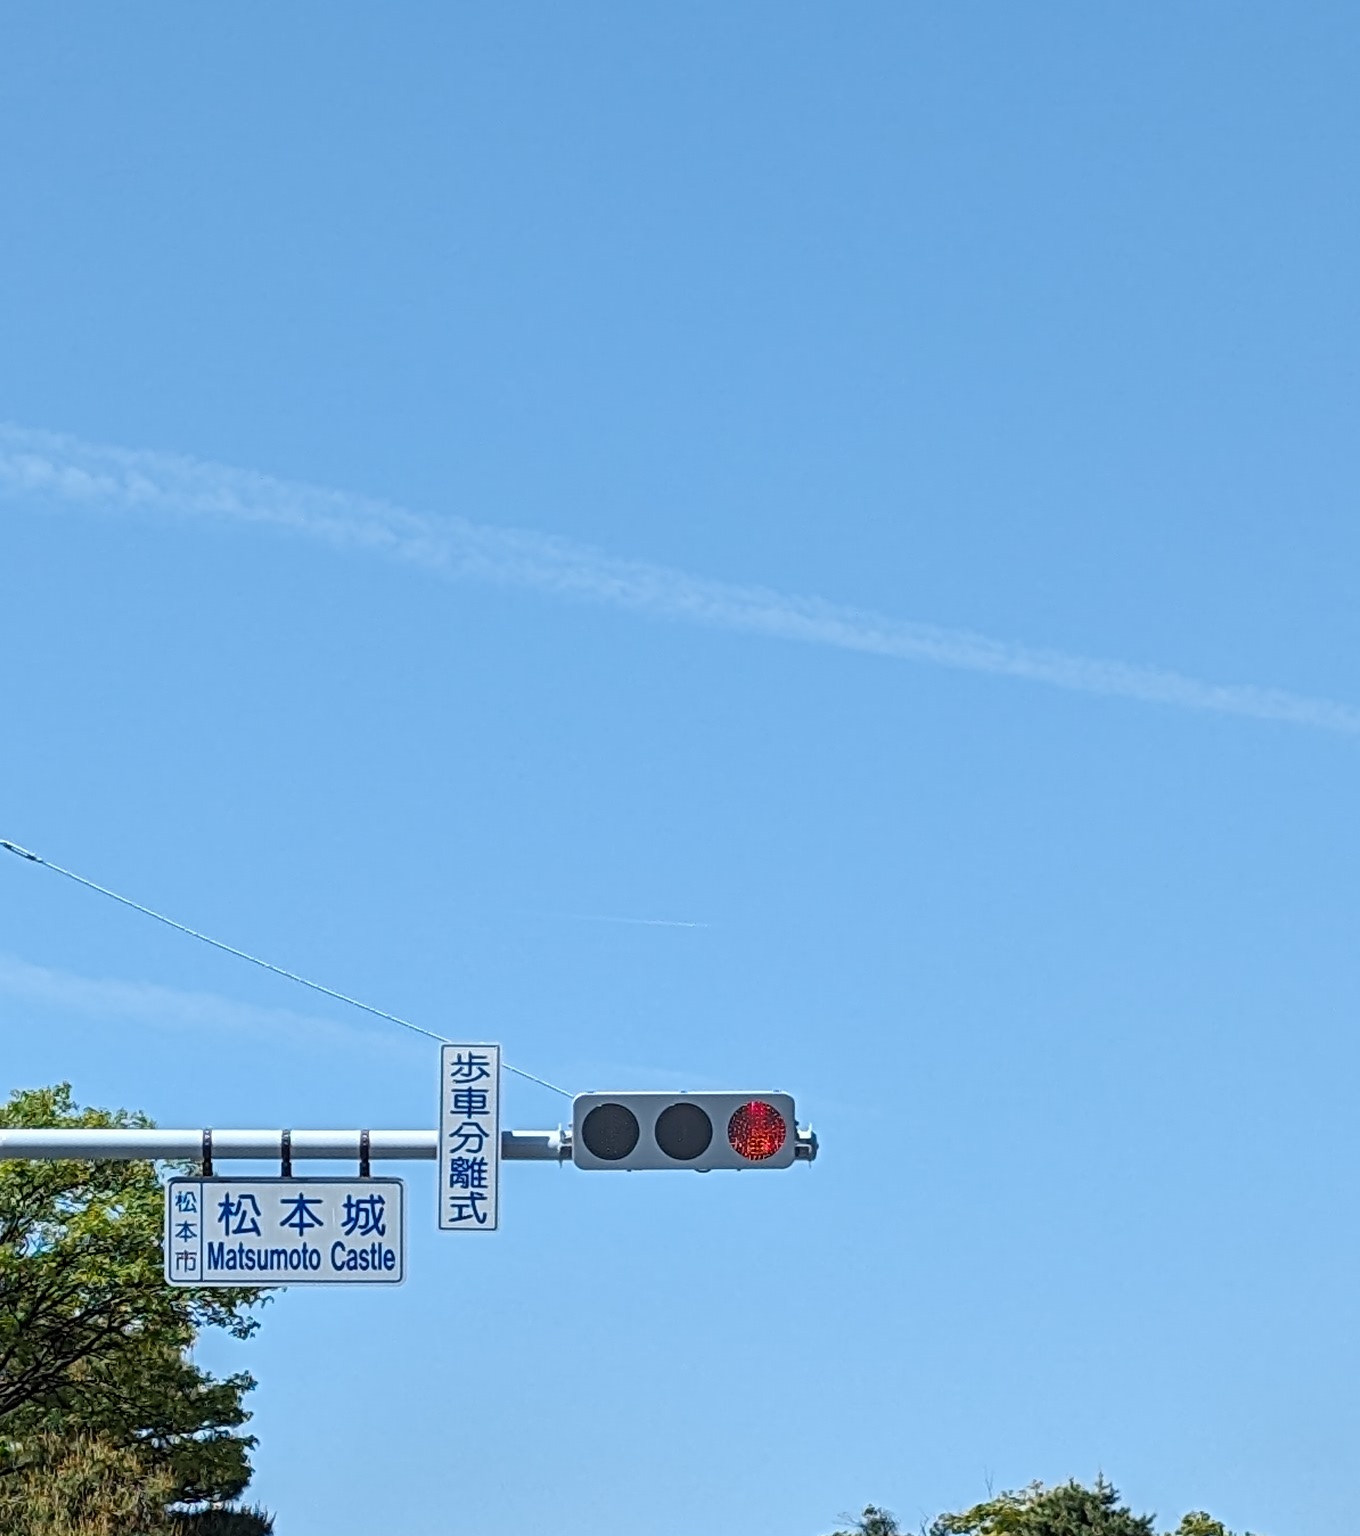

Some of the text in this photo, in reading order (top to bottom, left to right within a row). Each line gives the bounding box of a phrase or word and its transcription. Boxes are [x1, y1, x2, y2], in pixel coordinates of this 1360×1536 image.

[448, 1050, 491, 1225] 歩車分離式
[174, 1190, 198, 1273] 松本市
[216, 1191, 386, 1237] 松本城
[207, 1240, 396, 1271] Matsumoto Castle
